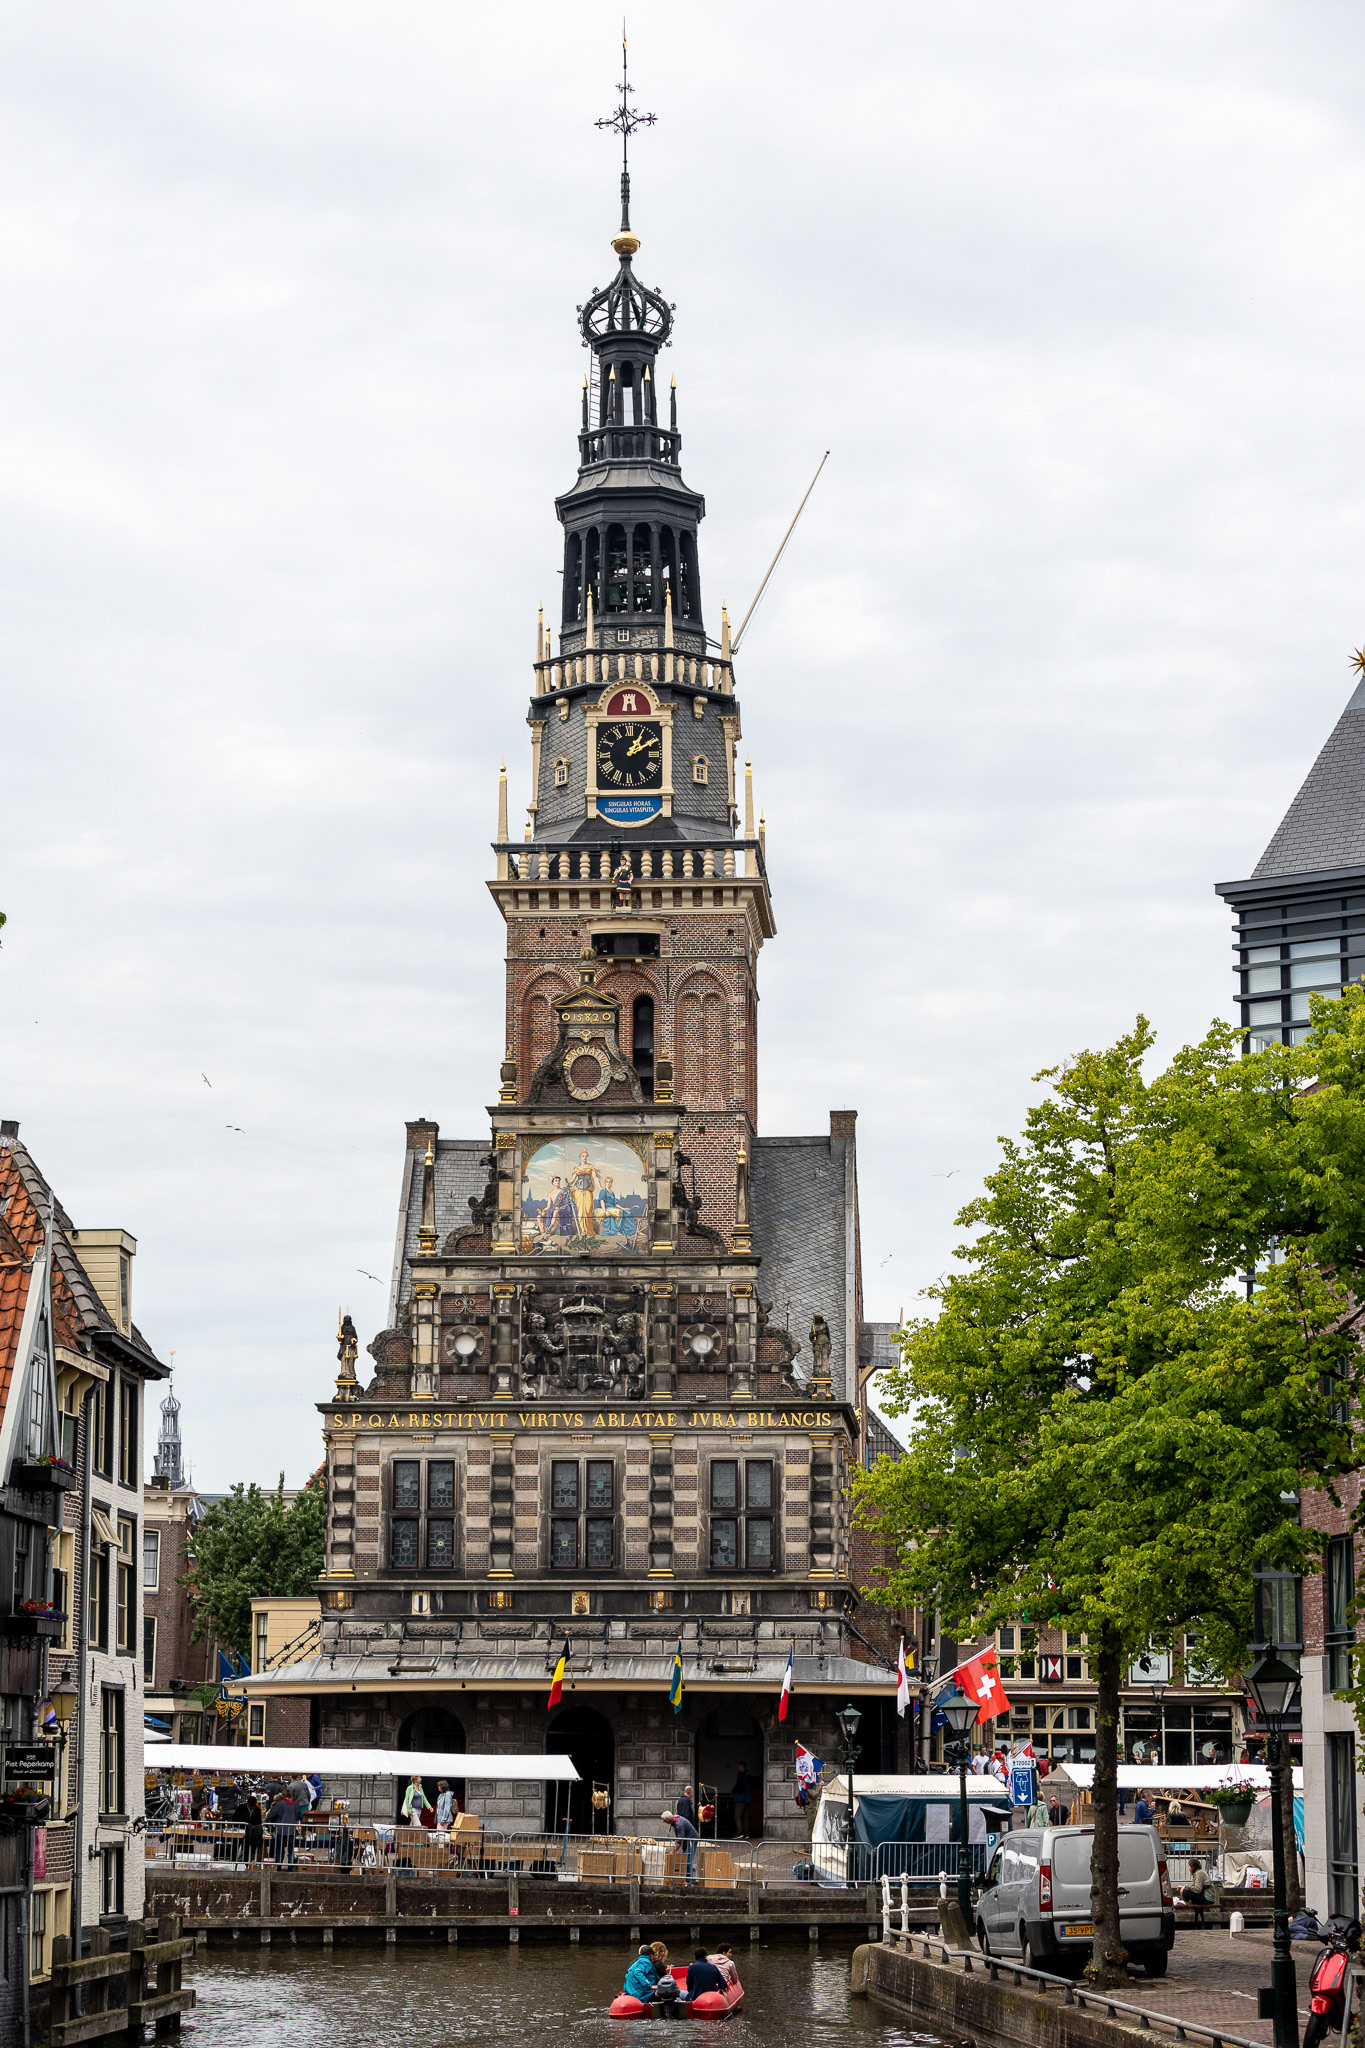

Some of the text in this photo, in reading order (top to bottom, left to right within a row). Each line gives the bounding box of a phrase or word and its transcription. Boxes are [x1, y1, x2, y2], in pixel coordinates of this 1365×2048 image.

[572, 1013, 600, 1021] 1582
[562, 1045, 610, 1068] RENOVATVM
[408, 1413, 508, 1428] RESTITVIT
[518, 1413, 584, 1428] VIRTVS
[594, 1413, 677, 1427] ABLATAE
[747, 1412, 832, 1427] BILANCIS
[19, 1760, 54, 1769] Peperkamp
[988, 1834, 996, 1844] P
